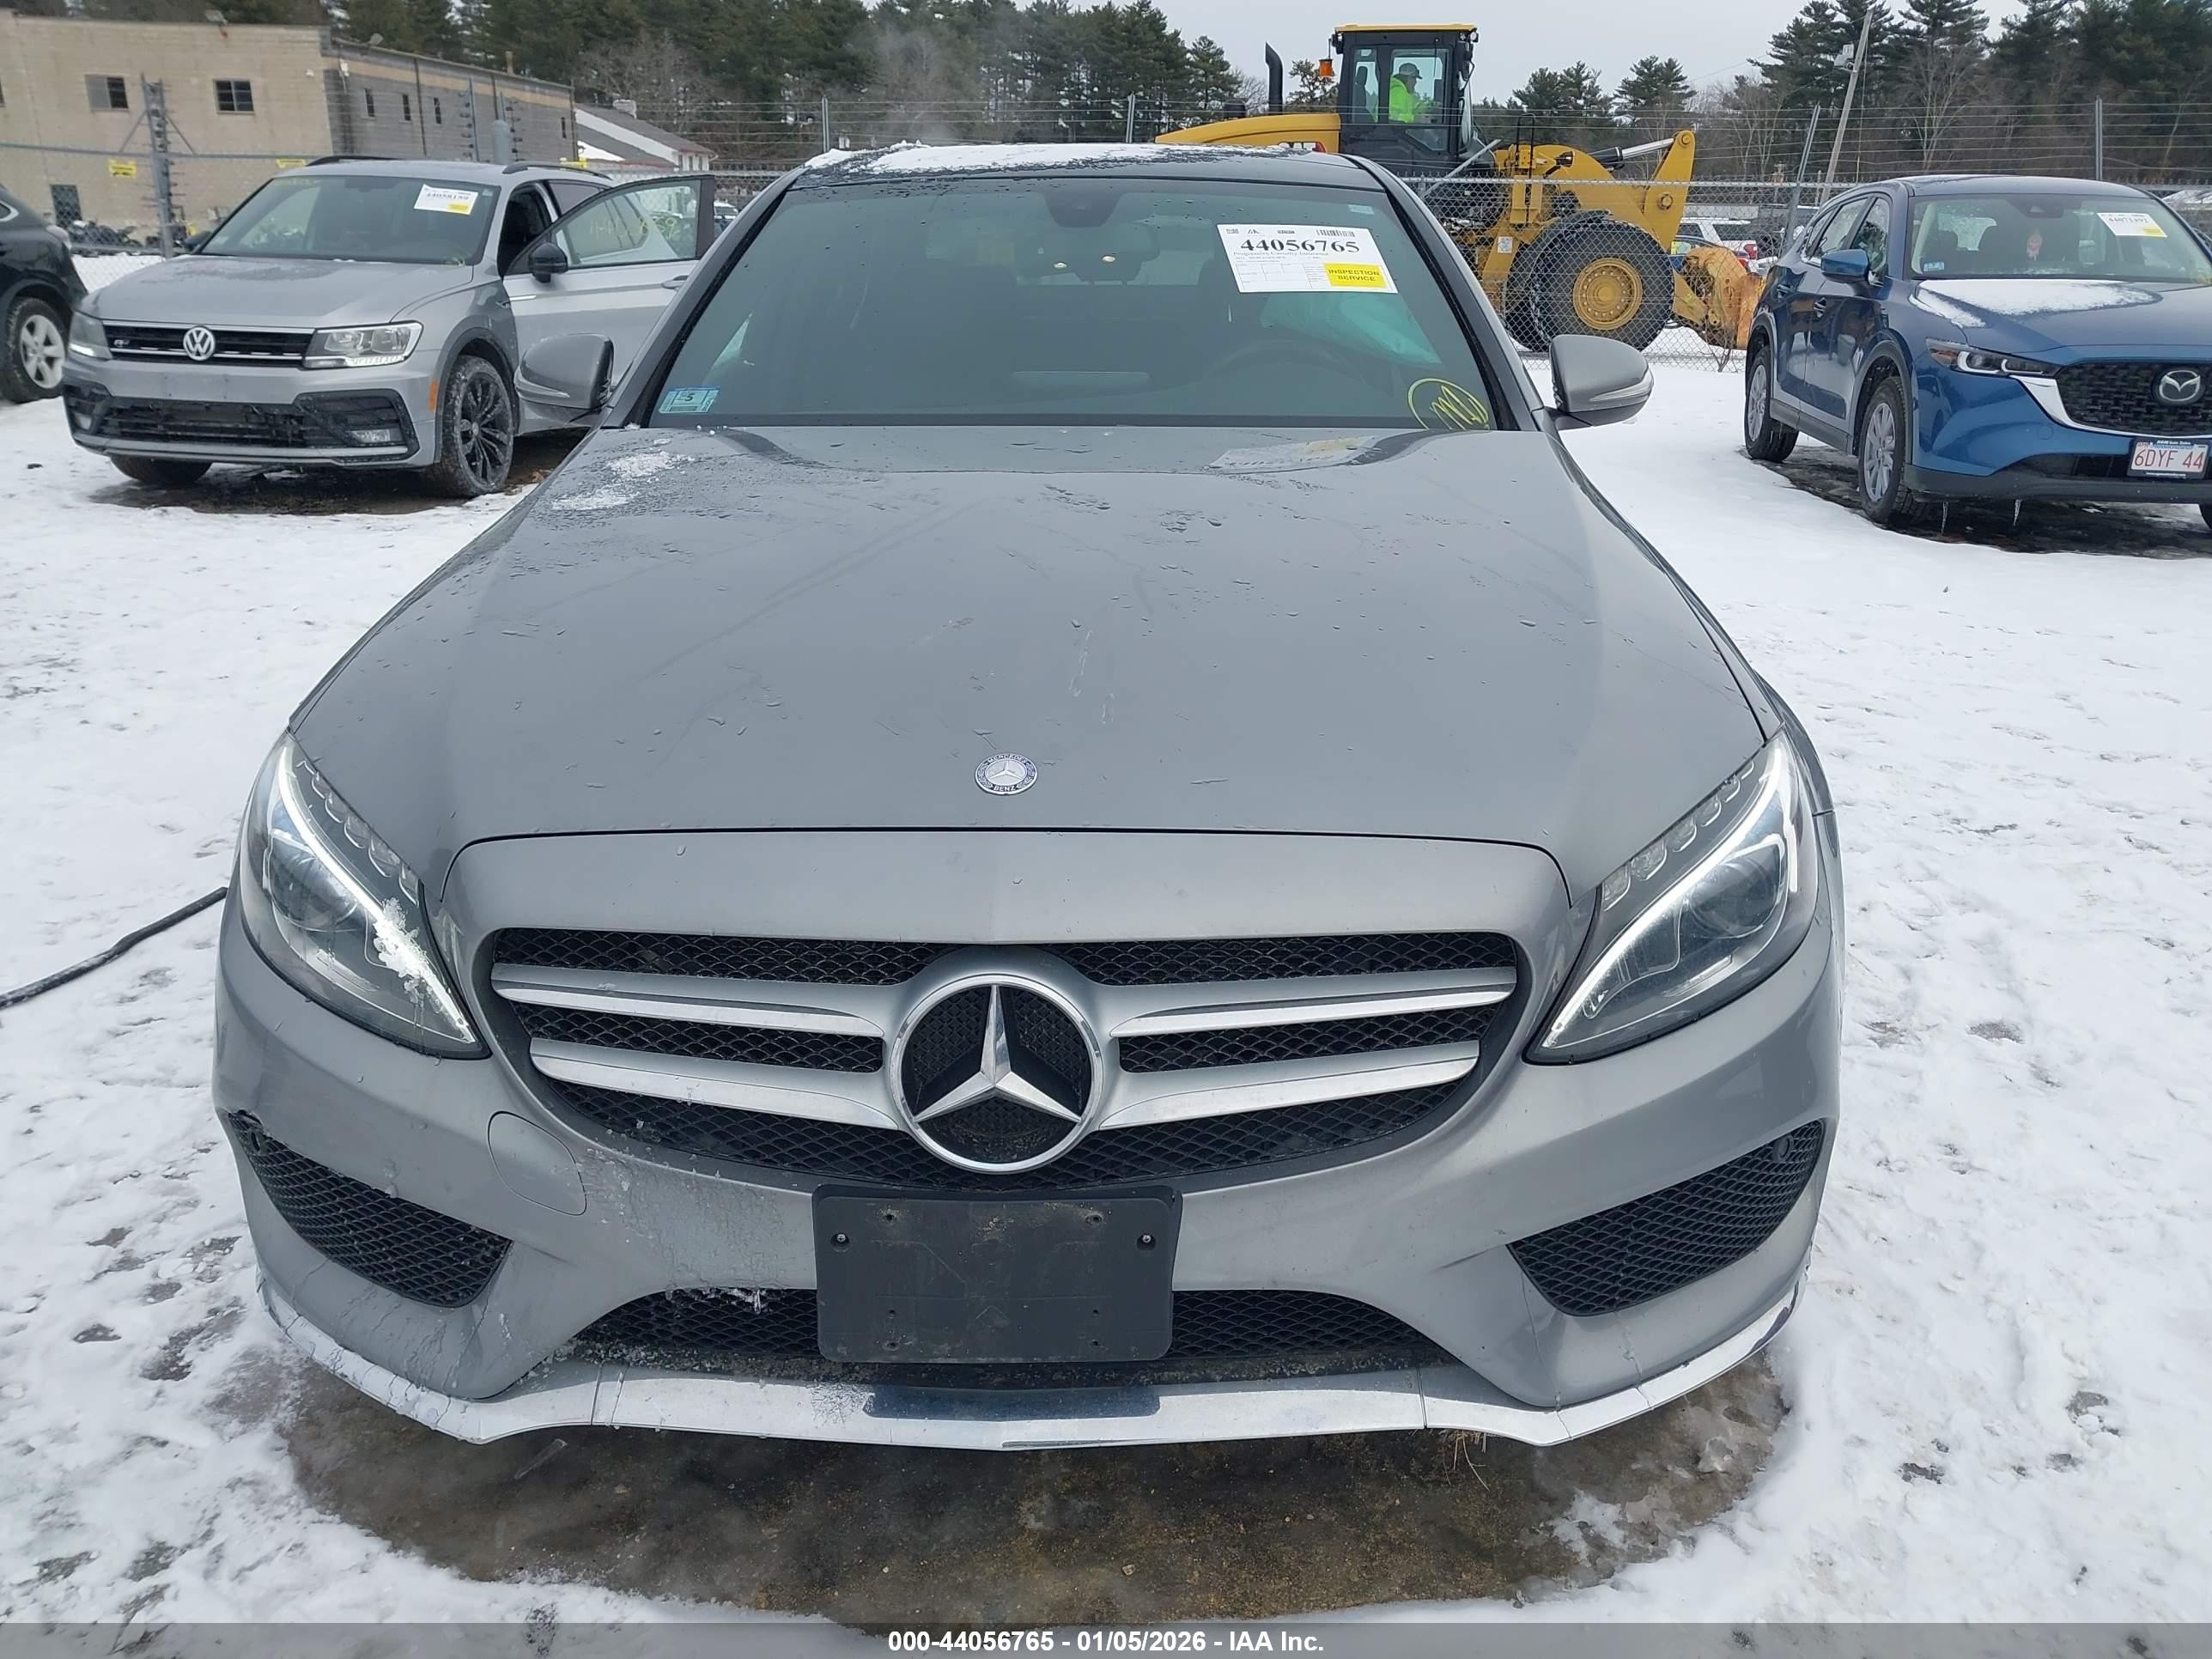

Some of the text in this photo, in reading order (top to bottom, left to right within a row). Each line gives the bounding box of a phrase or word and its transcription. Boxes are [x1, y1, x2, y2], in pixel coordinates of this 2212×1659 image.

[1240, 239, 1360, 253] 44056765
[2134, 448, 2204, 469] 6DYF 44
